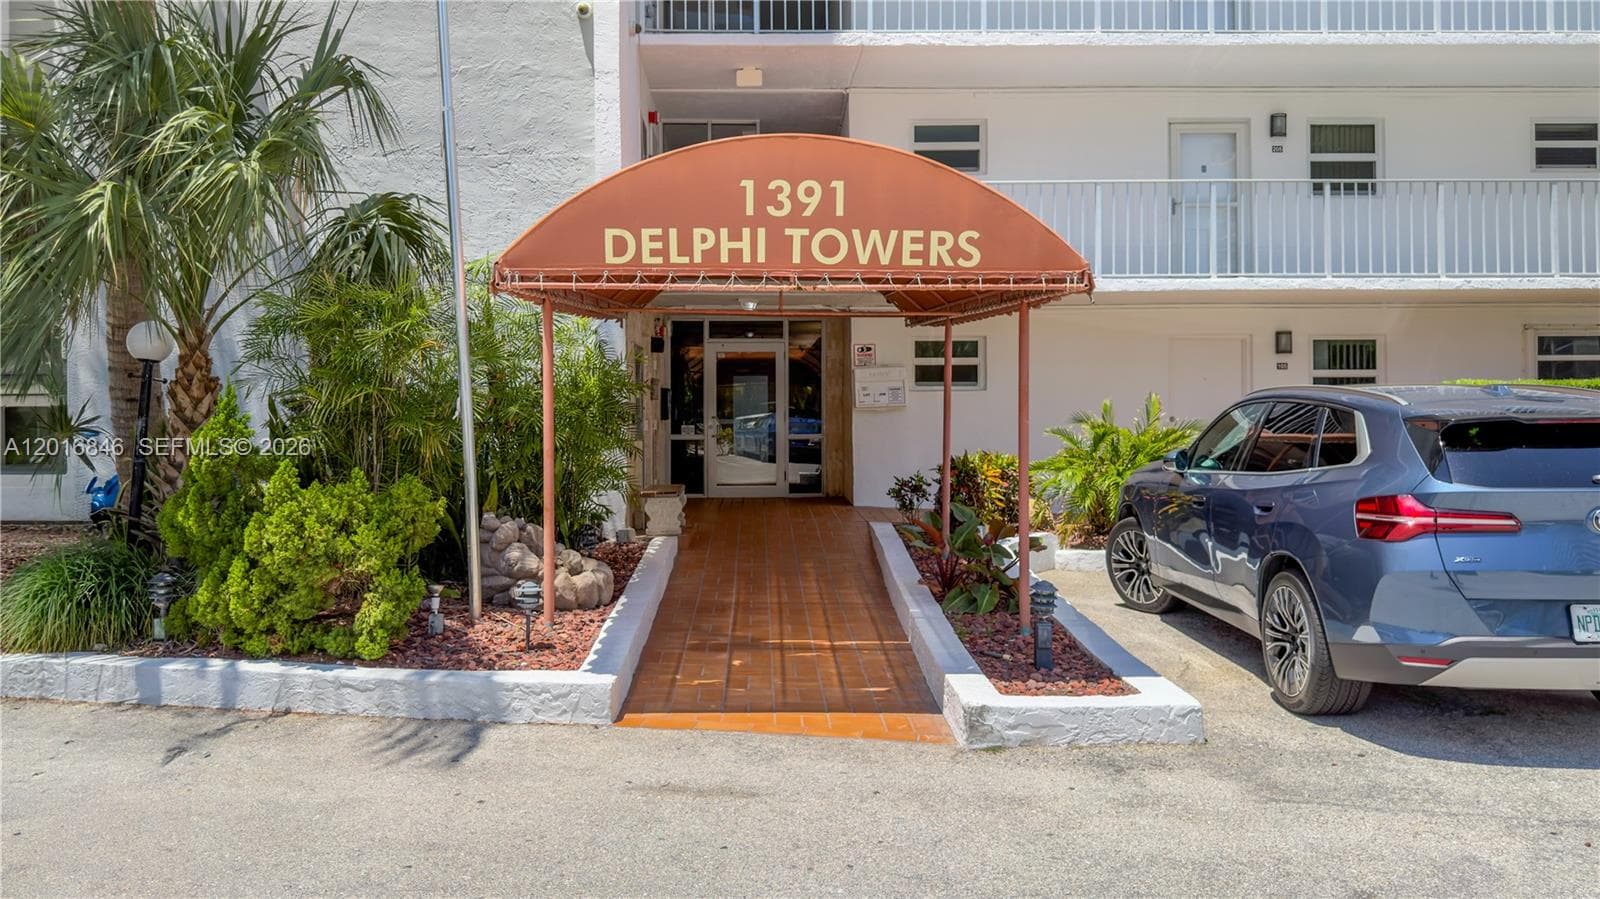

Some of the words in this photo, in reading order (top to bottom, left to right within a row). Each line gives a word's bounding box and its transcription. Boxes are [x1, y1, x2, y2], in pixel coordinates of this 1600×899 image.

[740, 179, 845, 217] 1391
[604, 227, 766, 264] DELPHI
[785, 227, 982, 268] TOWERS
